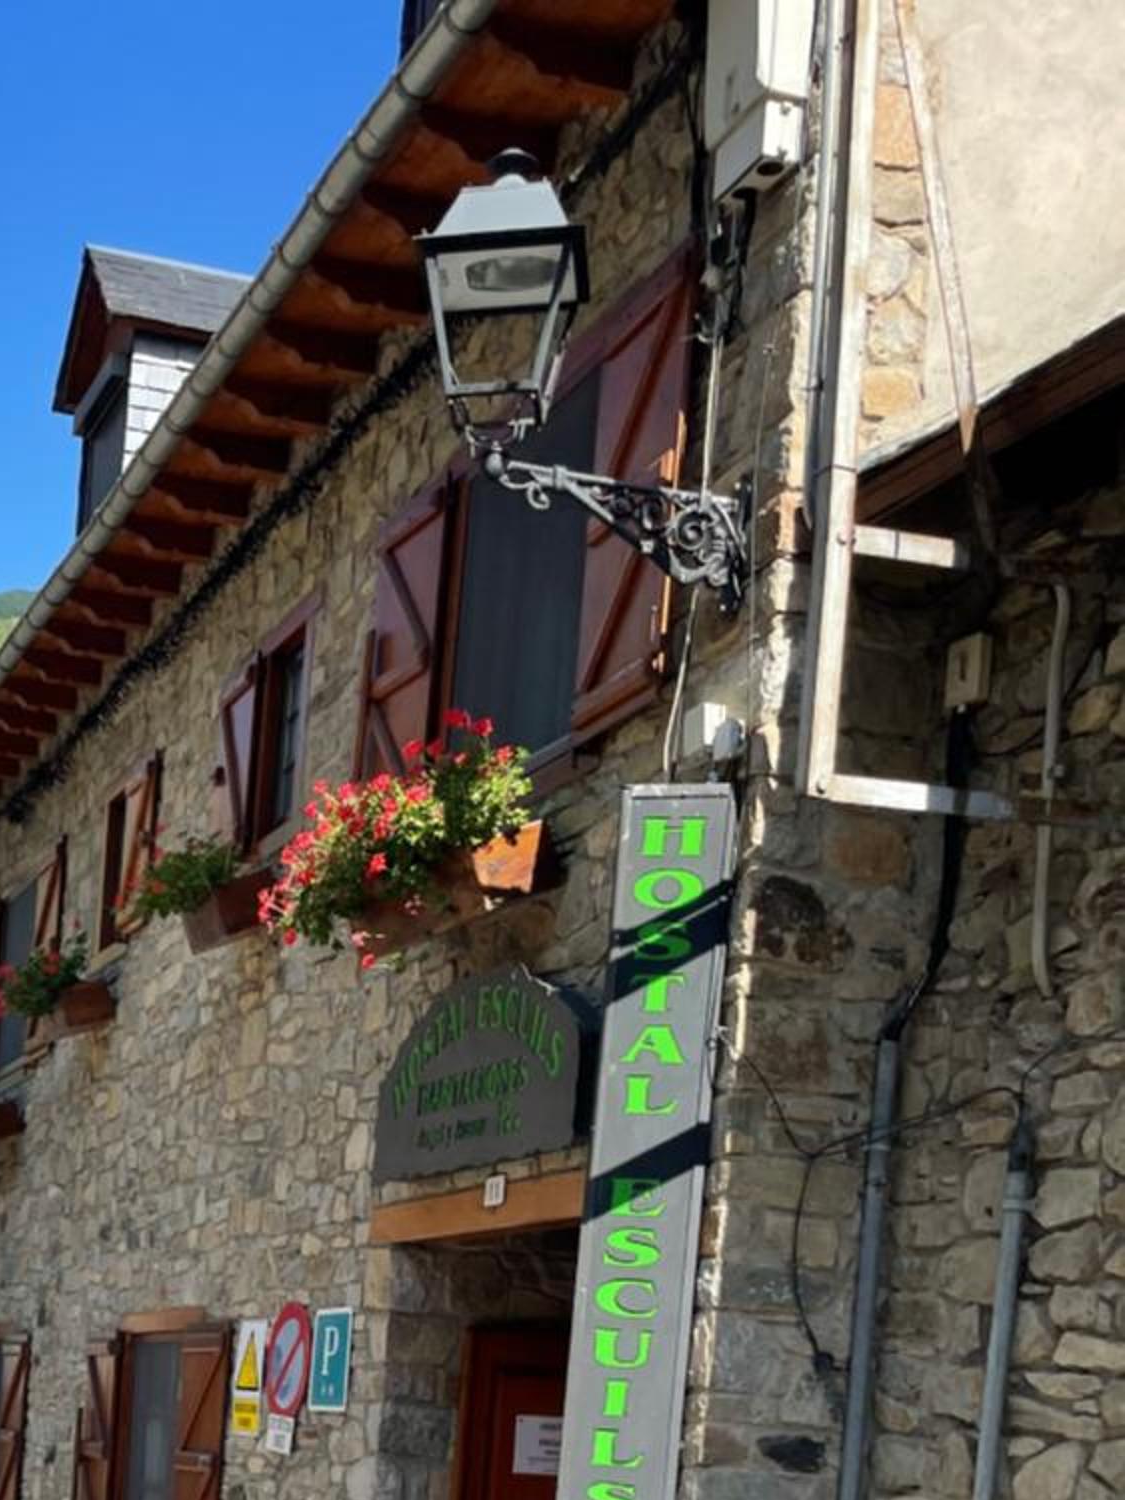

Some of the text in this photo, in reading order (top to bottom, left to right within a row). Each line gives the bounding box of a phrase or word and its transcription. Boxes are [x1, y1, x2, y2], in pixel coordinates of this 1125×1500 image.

[619, 814, 708, 1118] HOSTAL
[477, 984, 564, 1080] ESCUILS
[321, 1325, 340, 1376] P
